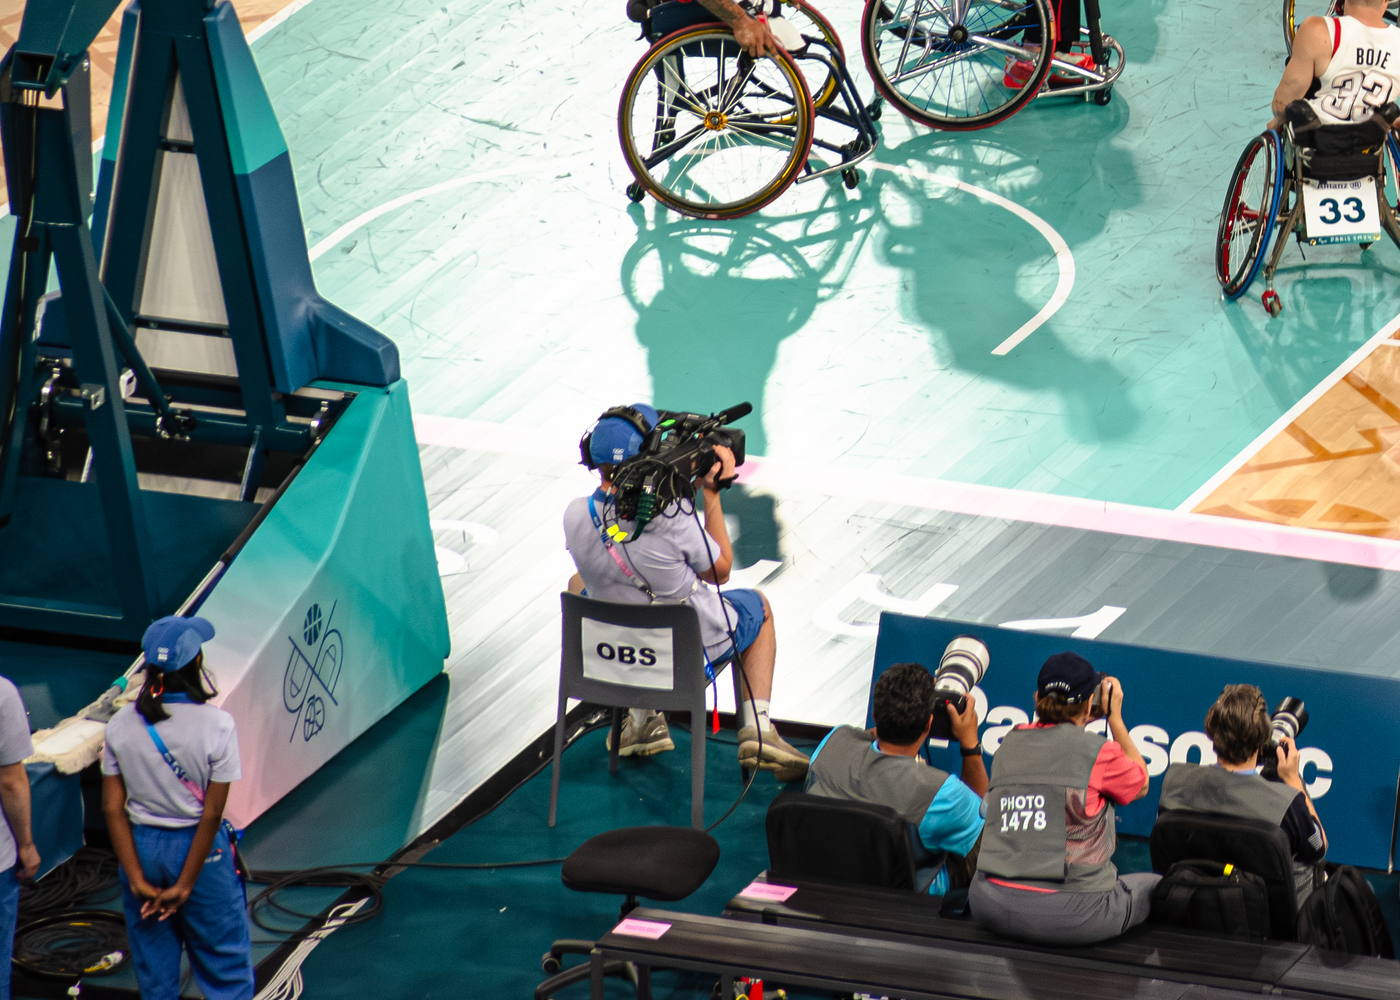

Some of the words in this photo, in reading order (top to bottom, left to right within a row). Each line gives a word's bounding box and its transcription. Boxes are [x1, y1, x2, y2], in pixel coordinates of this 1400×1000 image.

[1356, 47, 1391, 70] BOJE
[1321, 69, 1394, 122] 33
[1319, 196, 1366, 225] 33
[596, 642, 657, 666] OBS
[1000, 794, 1045, 811] PHOTO
[1000, 810, 1047, 832] 1478
